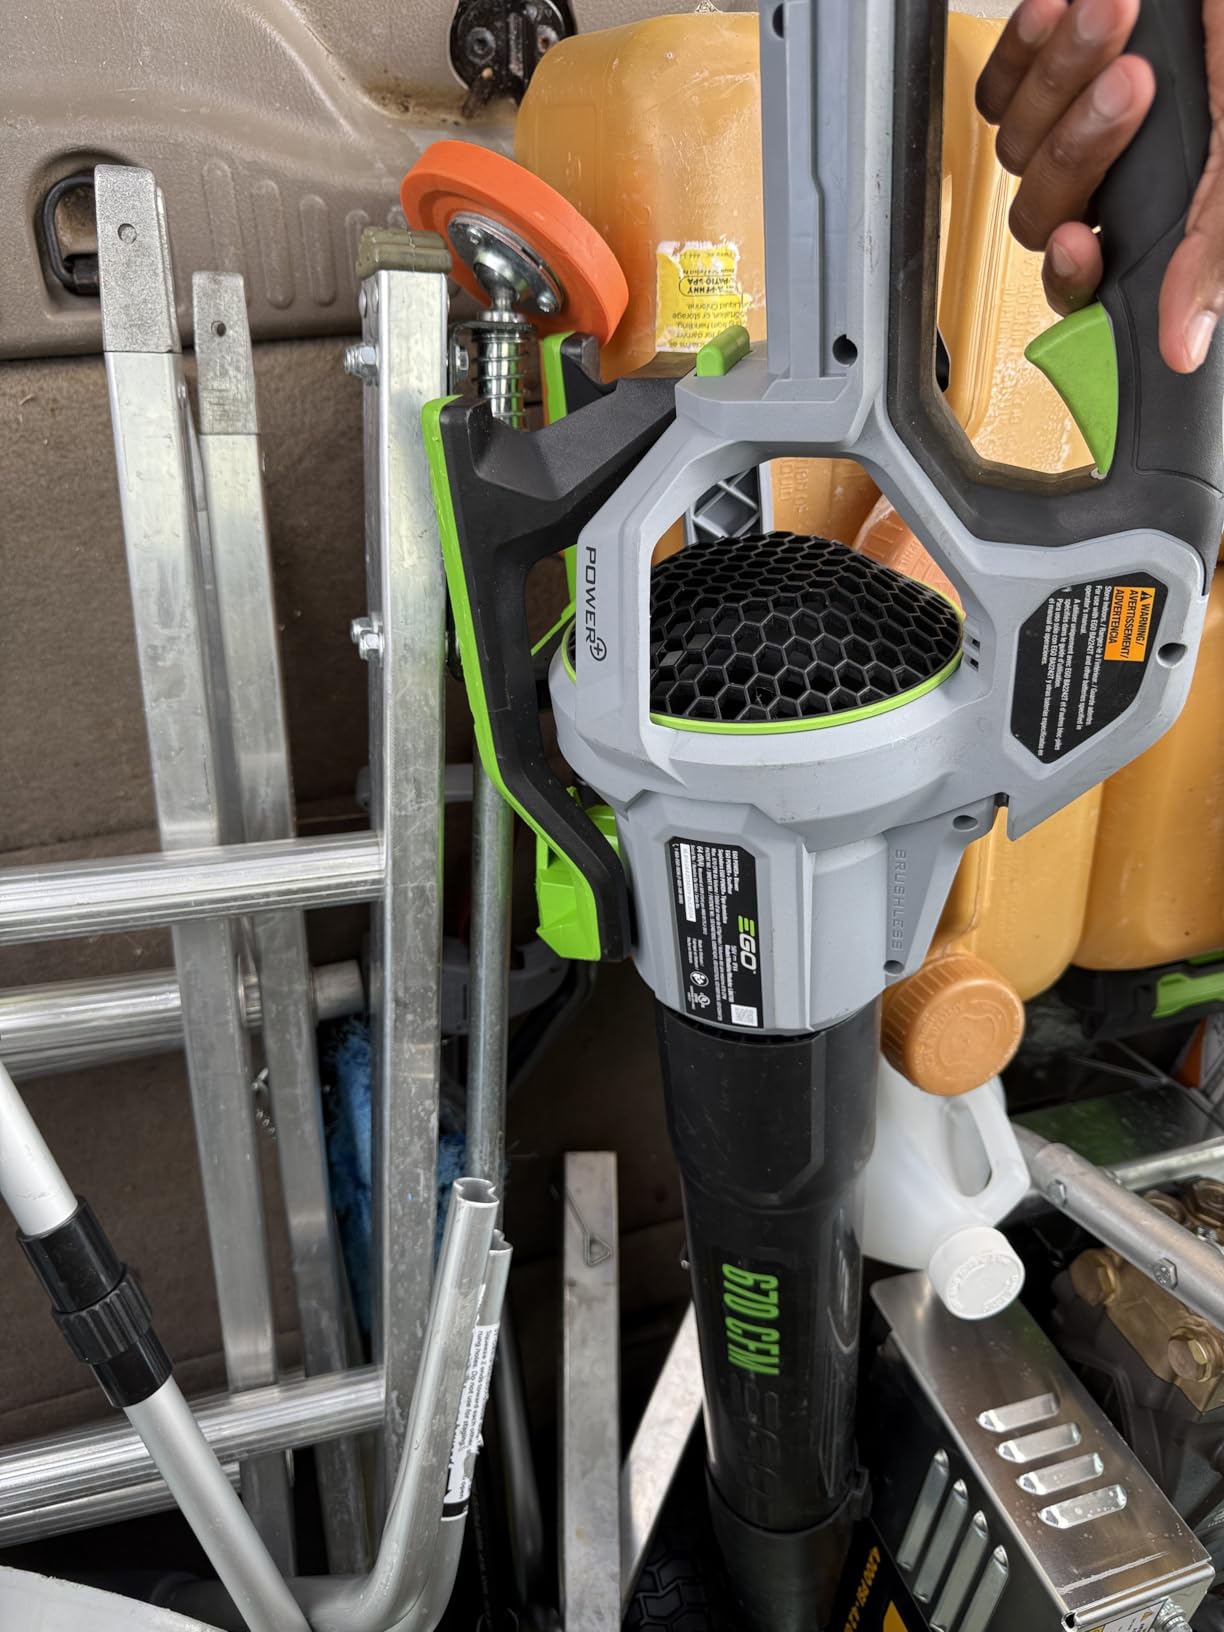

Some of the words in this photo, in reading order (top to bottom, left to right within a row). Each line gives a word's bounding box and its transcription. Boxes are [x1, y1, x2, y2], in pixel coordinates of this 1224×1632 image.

[672, 311, 701, 321] storage
[1083, 585, 1092, 612] operator's
[1103, 586, 1111, 601] Store
[1046, 604, 1054, 624] manual
[1054, 598, 1062, 611] Para
[1063, 599, 1071, 622] spécifiés
[1100, 602, 1109, 622] Indoors.
[1080, 613, 1088, 634] manual.
[1090, 619, 1098, 631] EGO
[1108, 589, 1125, 644] ADVERTENCIA
[1041, 633, 1050, 665] operaciones.
[1067, 623, 1076, 654] uniquement
[1087, 632, 1096, 655] BA2242T
[1096, 627, 1106, 653] Rangez-le
[1049, 645, 1057, 656] EGO
[1058, 643, 1066, 657] guide
[1047, 657, 1056, 679] BA2242T
[1055, 658, 1064, 688] d'utilisation.
[1064, 668, 1072, 678] EGO
[1083, 666, 1091, 679] other
[1061, 679, 1070, 701] BA2242T
[1080, 680, 1089, 702] batteries
[1088, 688, 1097, 706] Guarde
[1058, 707, 1066, 727] d'autres
[1077, 703, 1085, 724] specified
[1038, 717, 1047, 749] especificadas
[1055, 728, 1064, 750] bloc-piles
[891, 848, 907, 951] BRUSHLESS
[738, 915, 757, 970] EGO
[722, 1263, 780, 1320] 670
[474, 1330, 483, 1348] rung
[724, 1316, 781, 1376] CFM
[470, 1370, 478, 1381] Do
[463, 1408, 471, 1419] for
